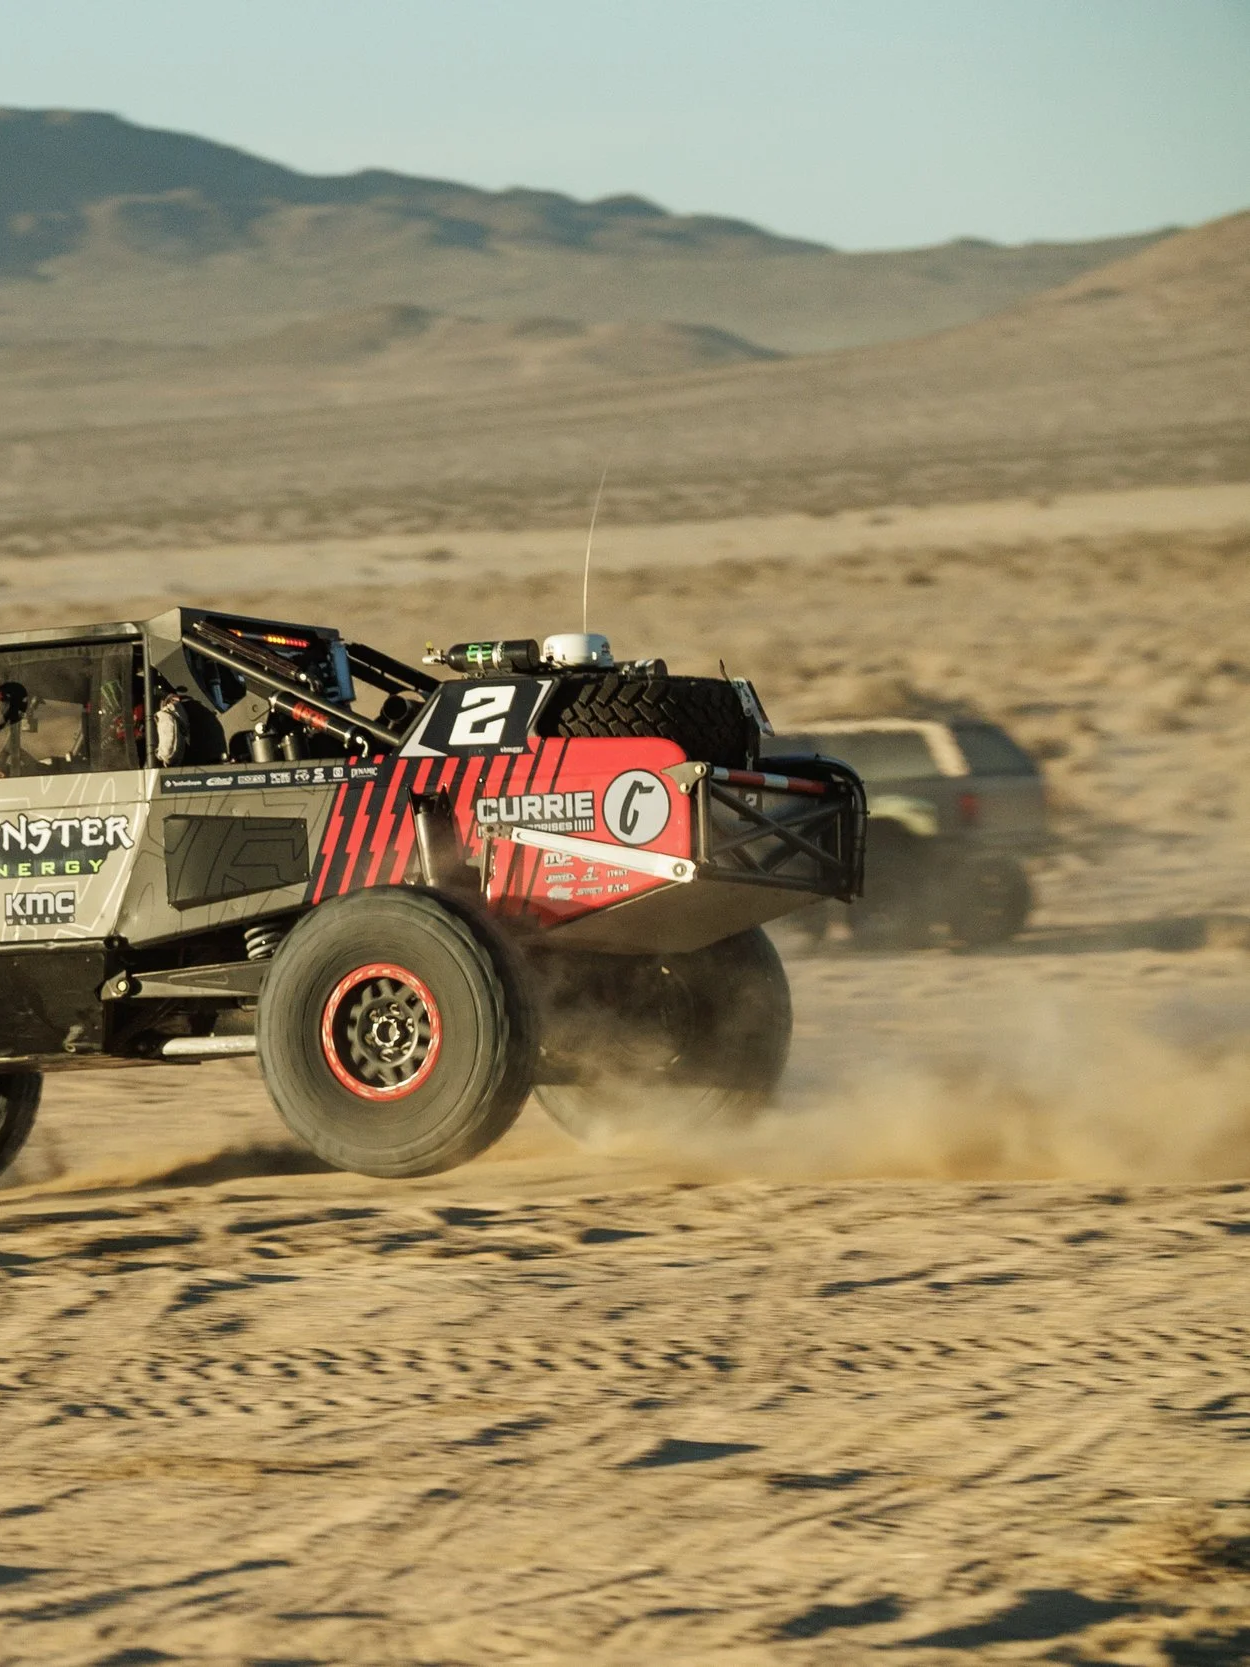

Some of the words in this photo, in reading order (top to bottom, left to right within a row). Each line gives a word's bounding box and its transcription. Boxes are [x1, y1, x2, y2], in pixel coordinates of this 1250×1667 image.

[448, 685, 516, 745] 2
[476, 791, 594, 823] CURRIE
[6, 891, 75, 916] KMC
